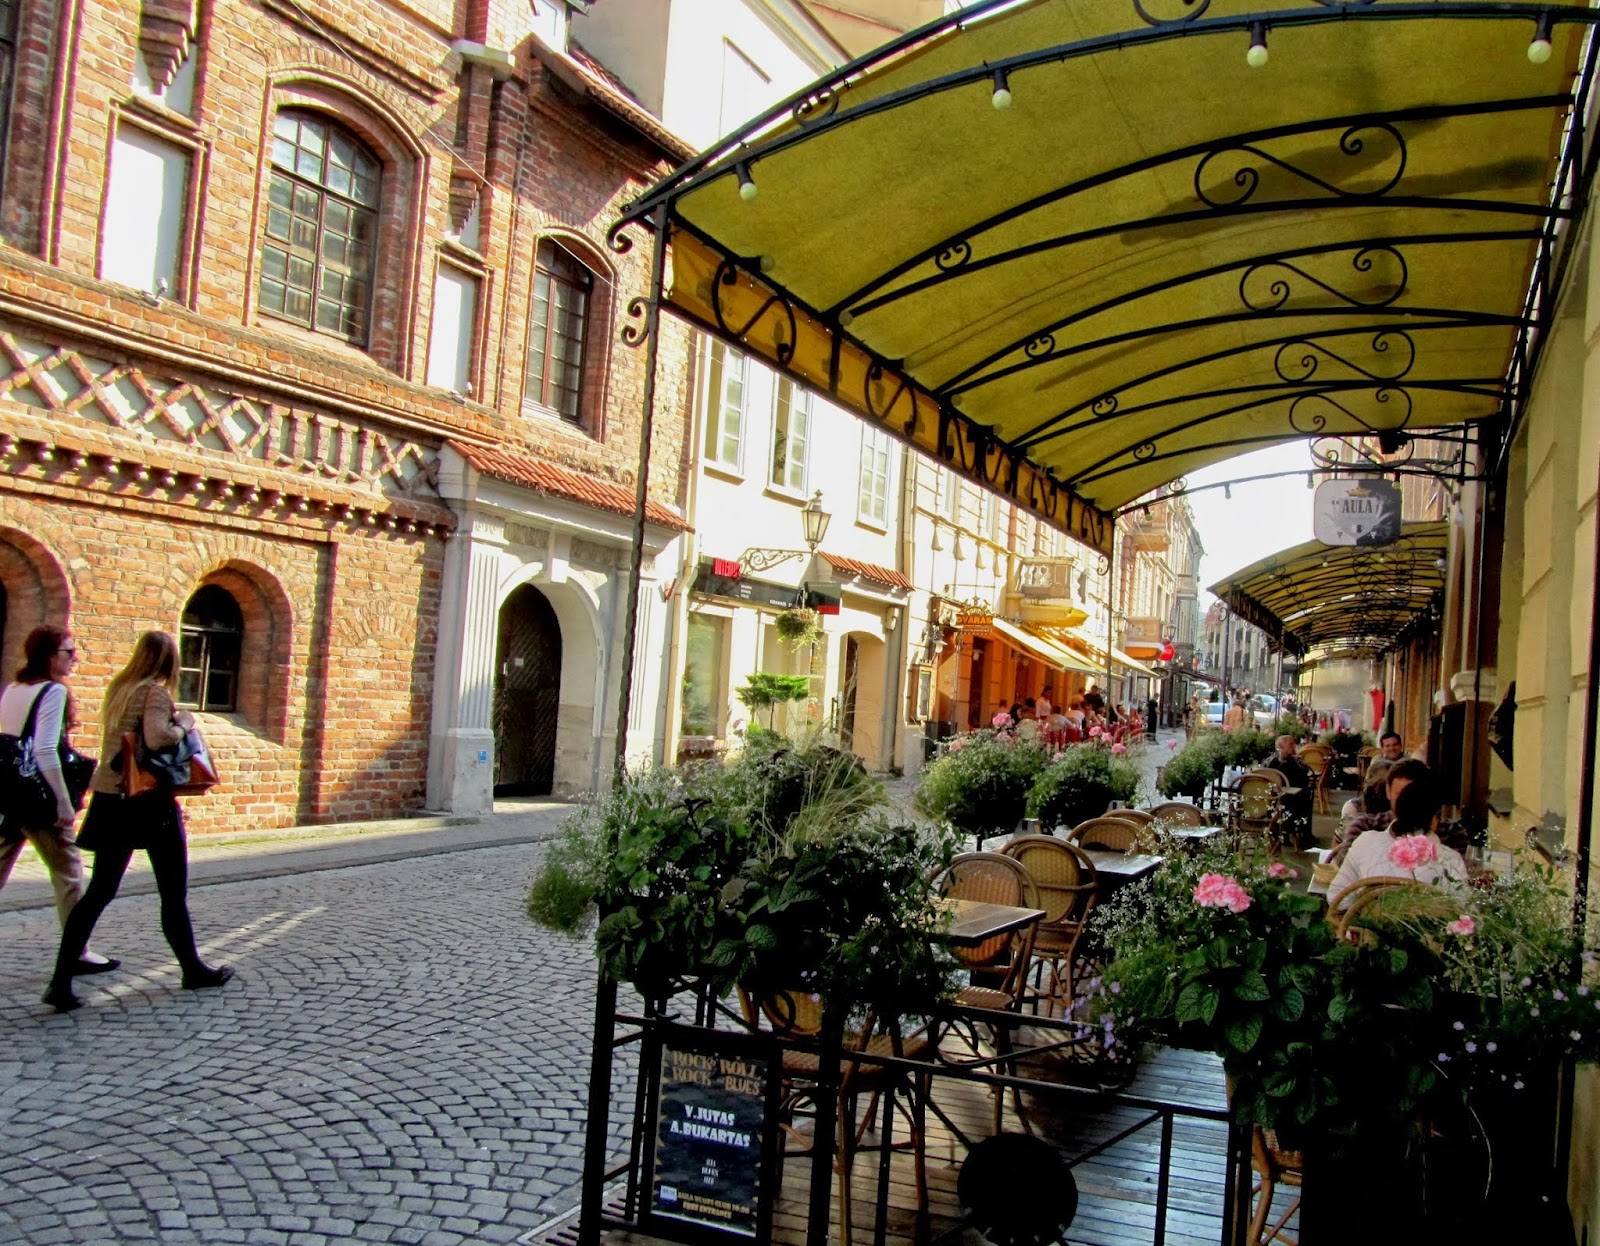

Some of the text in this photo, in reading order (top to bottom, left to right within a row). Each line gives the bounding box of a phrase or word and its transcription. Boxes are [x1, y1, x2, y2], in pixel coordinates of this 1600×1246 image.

[1342, 500, 1373, 514] AULA
[956, 616, 992, 625] DVARAS
[672, 1050, 712, 1071] ROCK
[672, 1067, 760, 1096] ROCK BLUES
[684, 1104, 735, 1126] V.JUTAS
[670, 1120, 751, 1148] A.BUKARTAS
[699, 1204, 733, 1219] ENTRANCE
